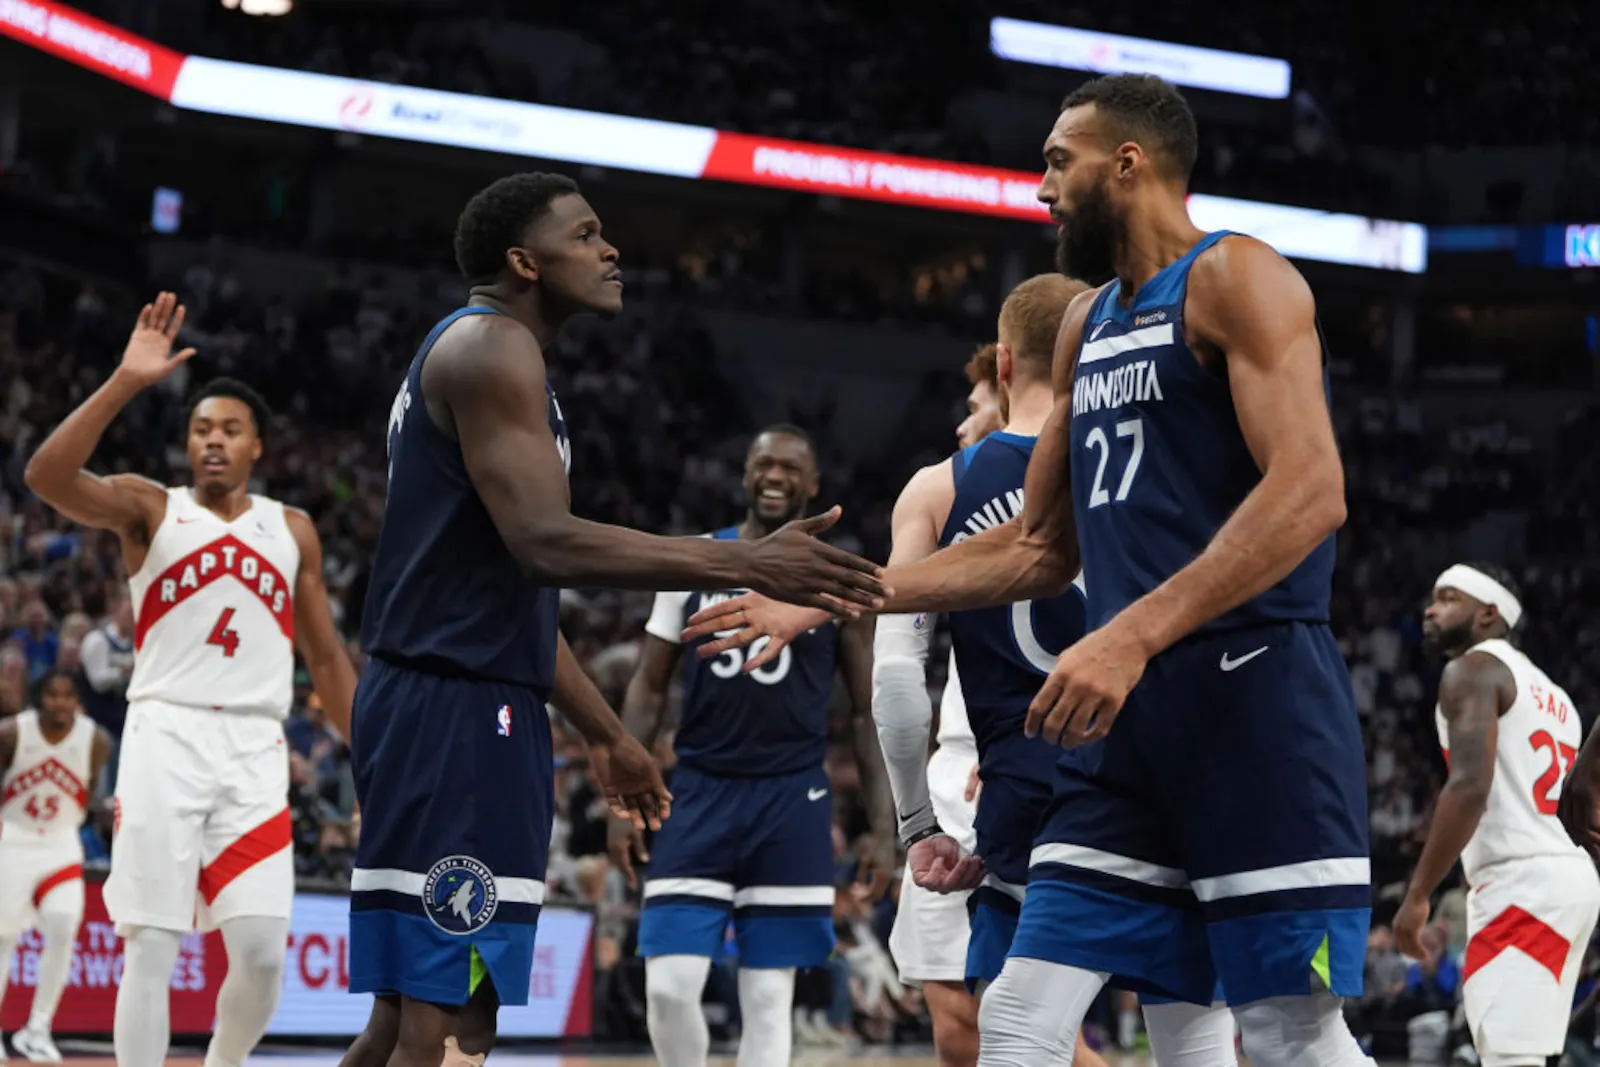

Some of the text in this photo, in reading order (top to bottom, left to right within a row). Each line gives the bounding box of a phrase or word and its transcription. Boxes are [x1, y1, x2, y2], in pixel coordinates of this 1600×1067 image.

[1072, 360, 1163, 418] MINNESOTA
[1085, 418, 1145, 509] 27
[160, 545, 286, 613] RAPTORS
[205, 606, 240, 658] 4
[24, 796, 59, 821] 45
[287, 932, 349, 990] CL
